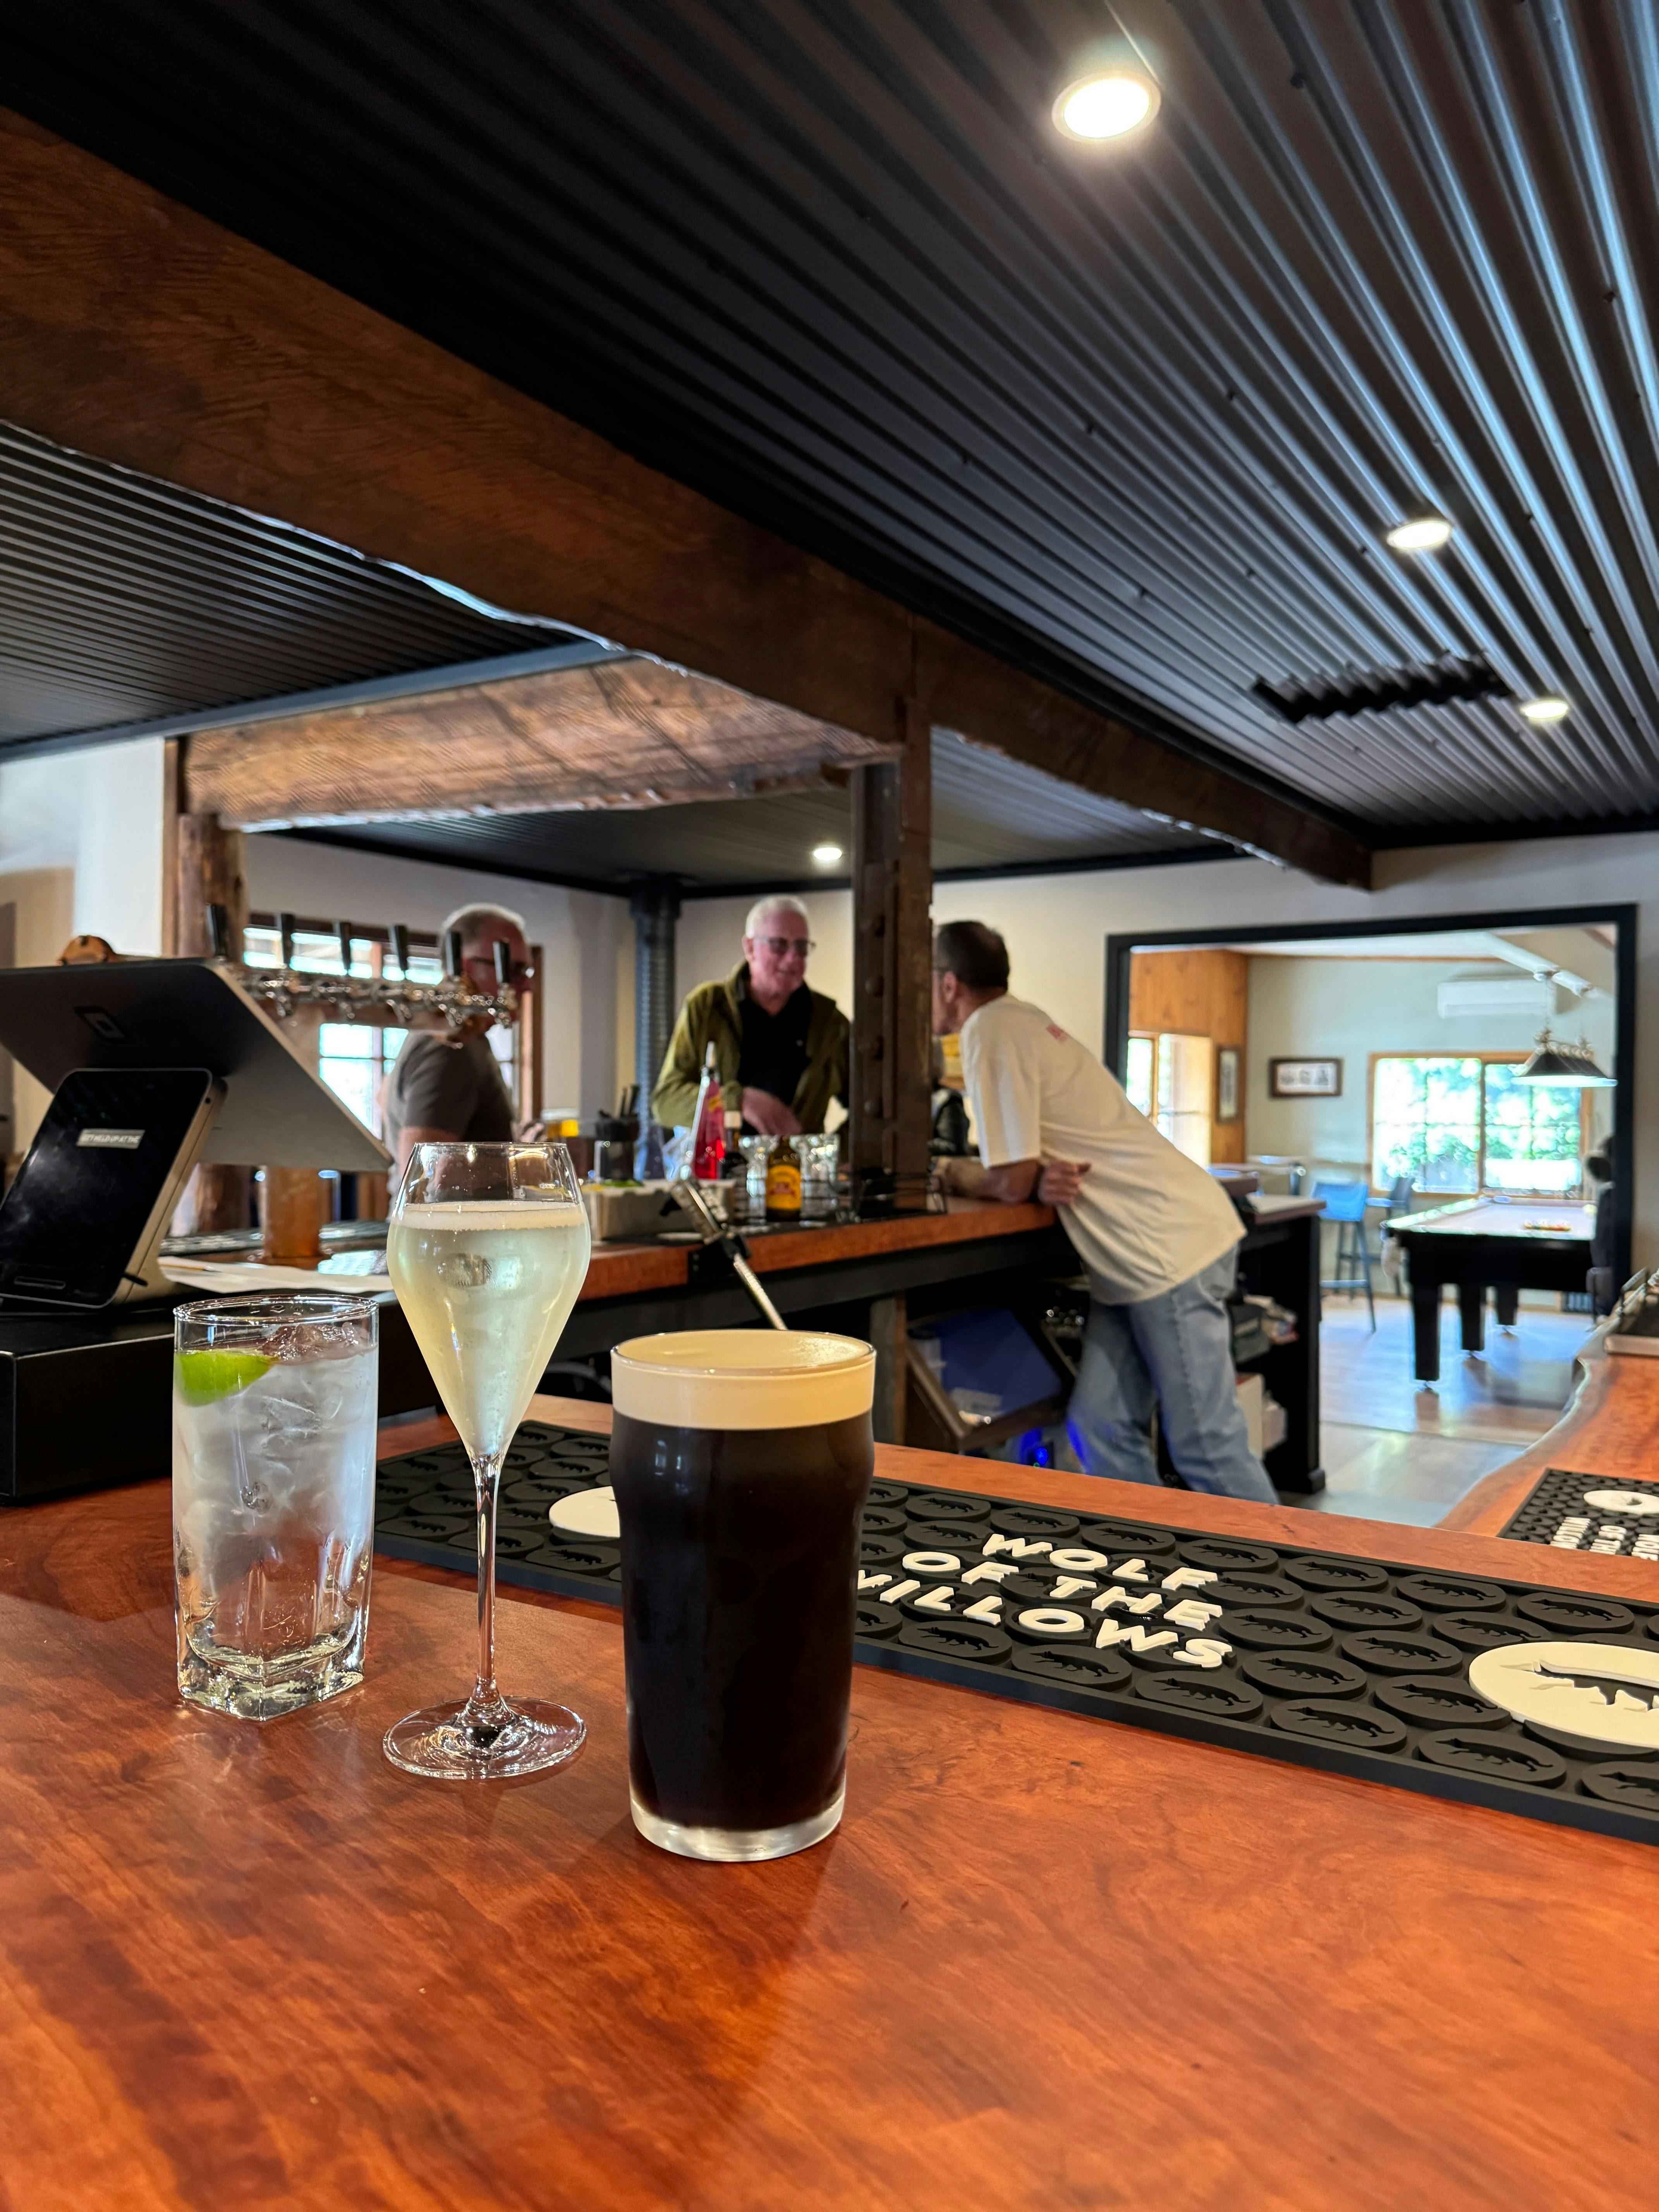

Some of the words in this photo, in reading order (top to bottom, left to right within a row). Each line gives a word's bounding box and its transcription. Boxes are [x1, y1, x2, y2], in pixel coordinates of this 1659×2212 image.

[1549, 1516, 1591, 1549] WILLOW
[902, 1551, 1019, 1585] OF
[1049, 1575, 1223, 1631] THE
[982, 1534, 1218, 1591] WOLF
